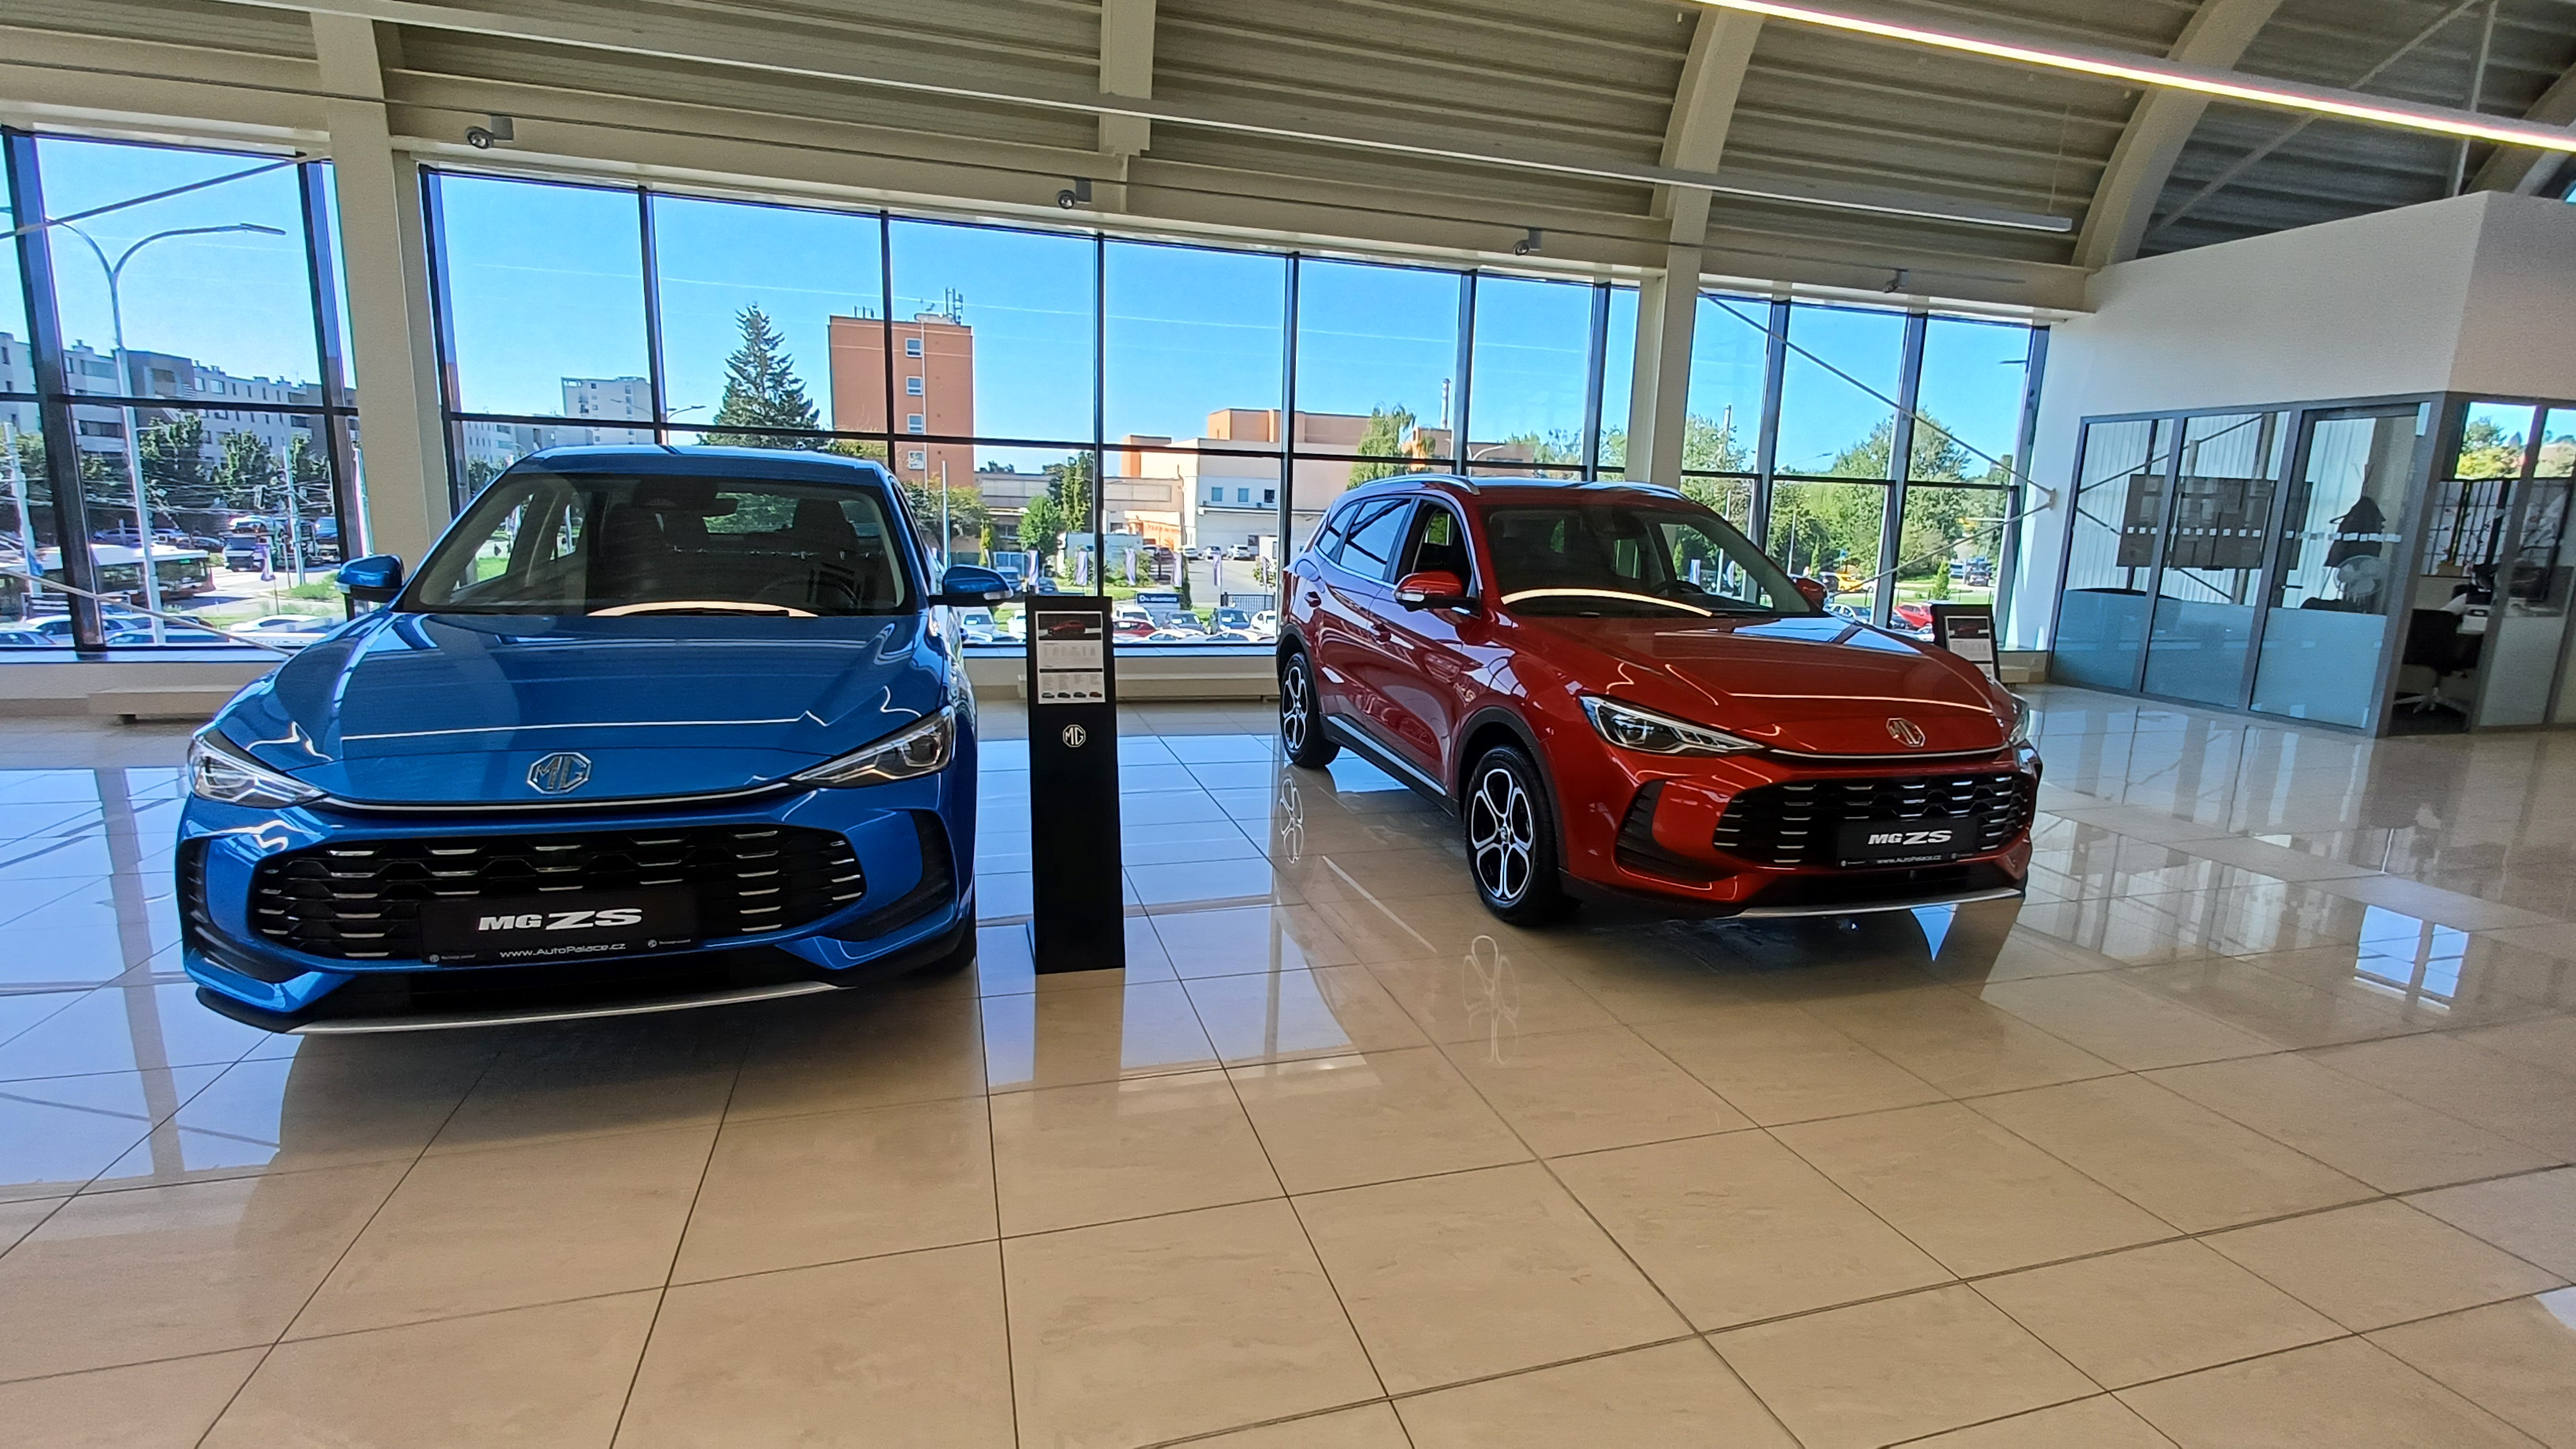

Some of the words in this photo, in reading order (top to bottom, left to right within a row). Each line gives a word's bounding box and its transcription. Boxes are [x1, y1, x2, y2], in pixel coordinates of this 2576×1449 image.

[1064, 726, 1085, 745] MG
[530, 754, 590, 791] MG
[1867, 833, 1902, 844] MG
[1903, 830, 1953, 845] ZS
[478, 914, 543, 931] MG
[545, 908, 642, 930] ZS
[500, 943, 627, 958] www.AutoPalace.cz
